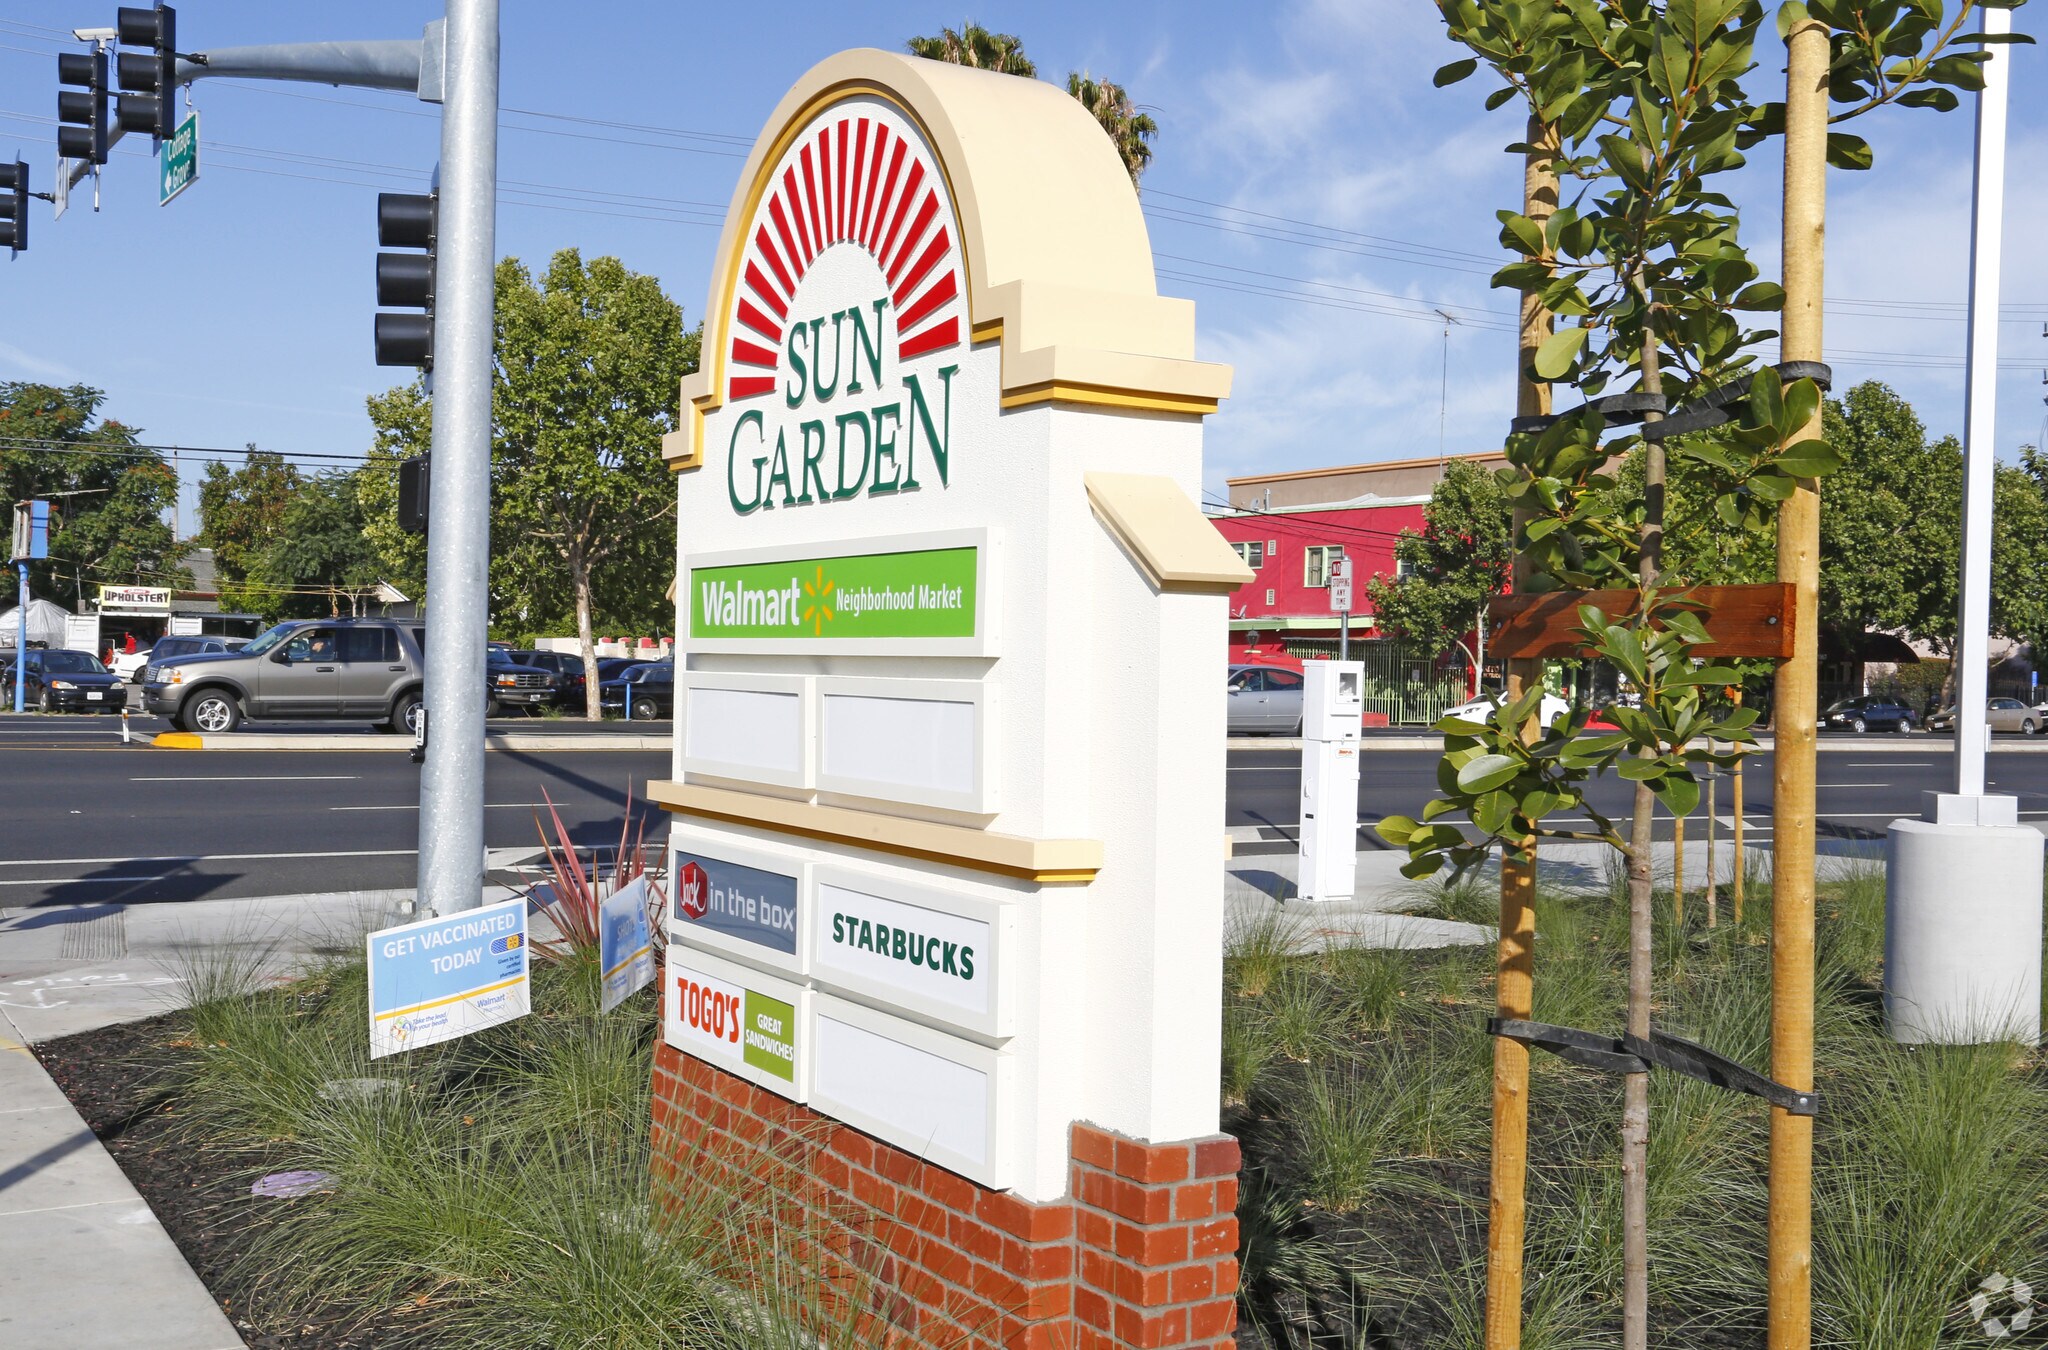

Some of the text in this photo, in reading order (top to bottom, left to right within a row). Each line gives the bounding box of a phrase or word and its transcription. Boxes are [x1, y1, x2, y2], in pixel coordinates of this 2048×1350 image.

[168, 127, 191, 161] Cottage
[172, 160, 190, 189] Grove
[786, 297, 888, 407] SUN
[728, 364, 959, 514] GARDEN
[104, 590, 170, 603] UPHOLSTERY
[1333, 577, 1349, 587] STOPPING
[702, 577, 962, 626] Walmart Neighborhood Market
[1336, 597, 1346, 605] TIME
[680, 872, 793, 933] Jack in the box
[383, 912, 516, 959] GET VACCINATED
[832, 912, 975, 980] STARBUCKS
[431, 947, 482, 975] TODAY
[476, 993, 505, 1008] Walmart
[677, 977, 740, 1044] TOGO'S
[413, 1011, 446, 1025] Take the lead
[418, 1022, 431, 1031] your
[432, 1017, 448, 1027] health
[757, 1013, 782, 1036] GREAT
[745, 1028, 794, 1062] SANDWICHES
